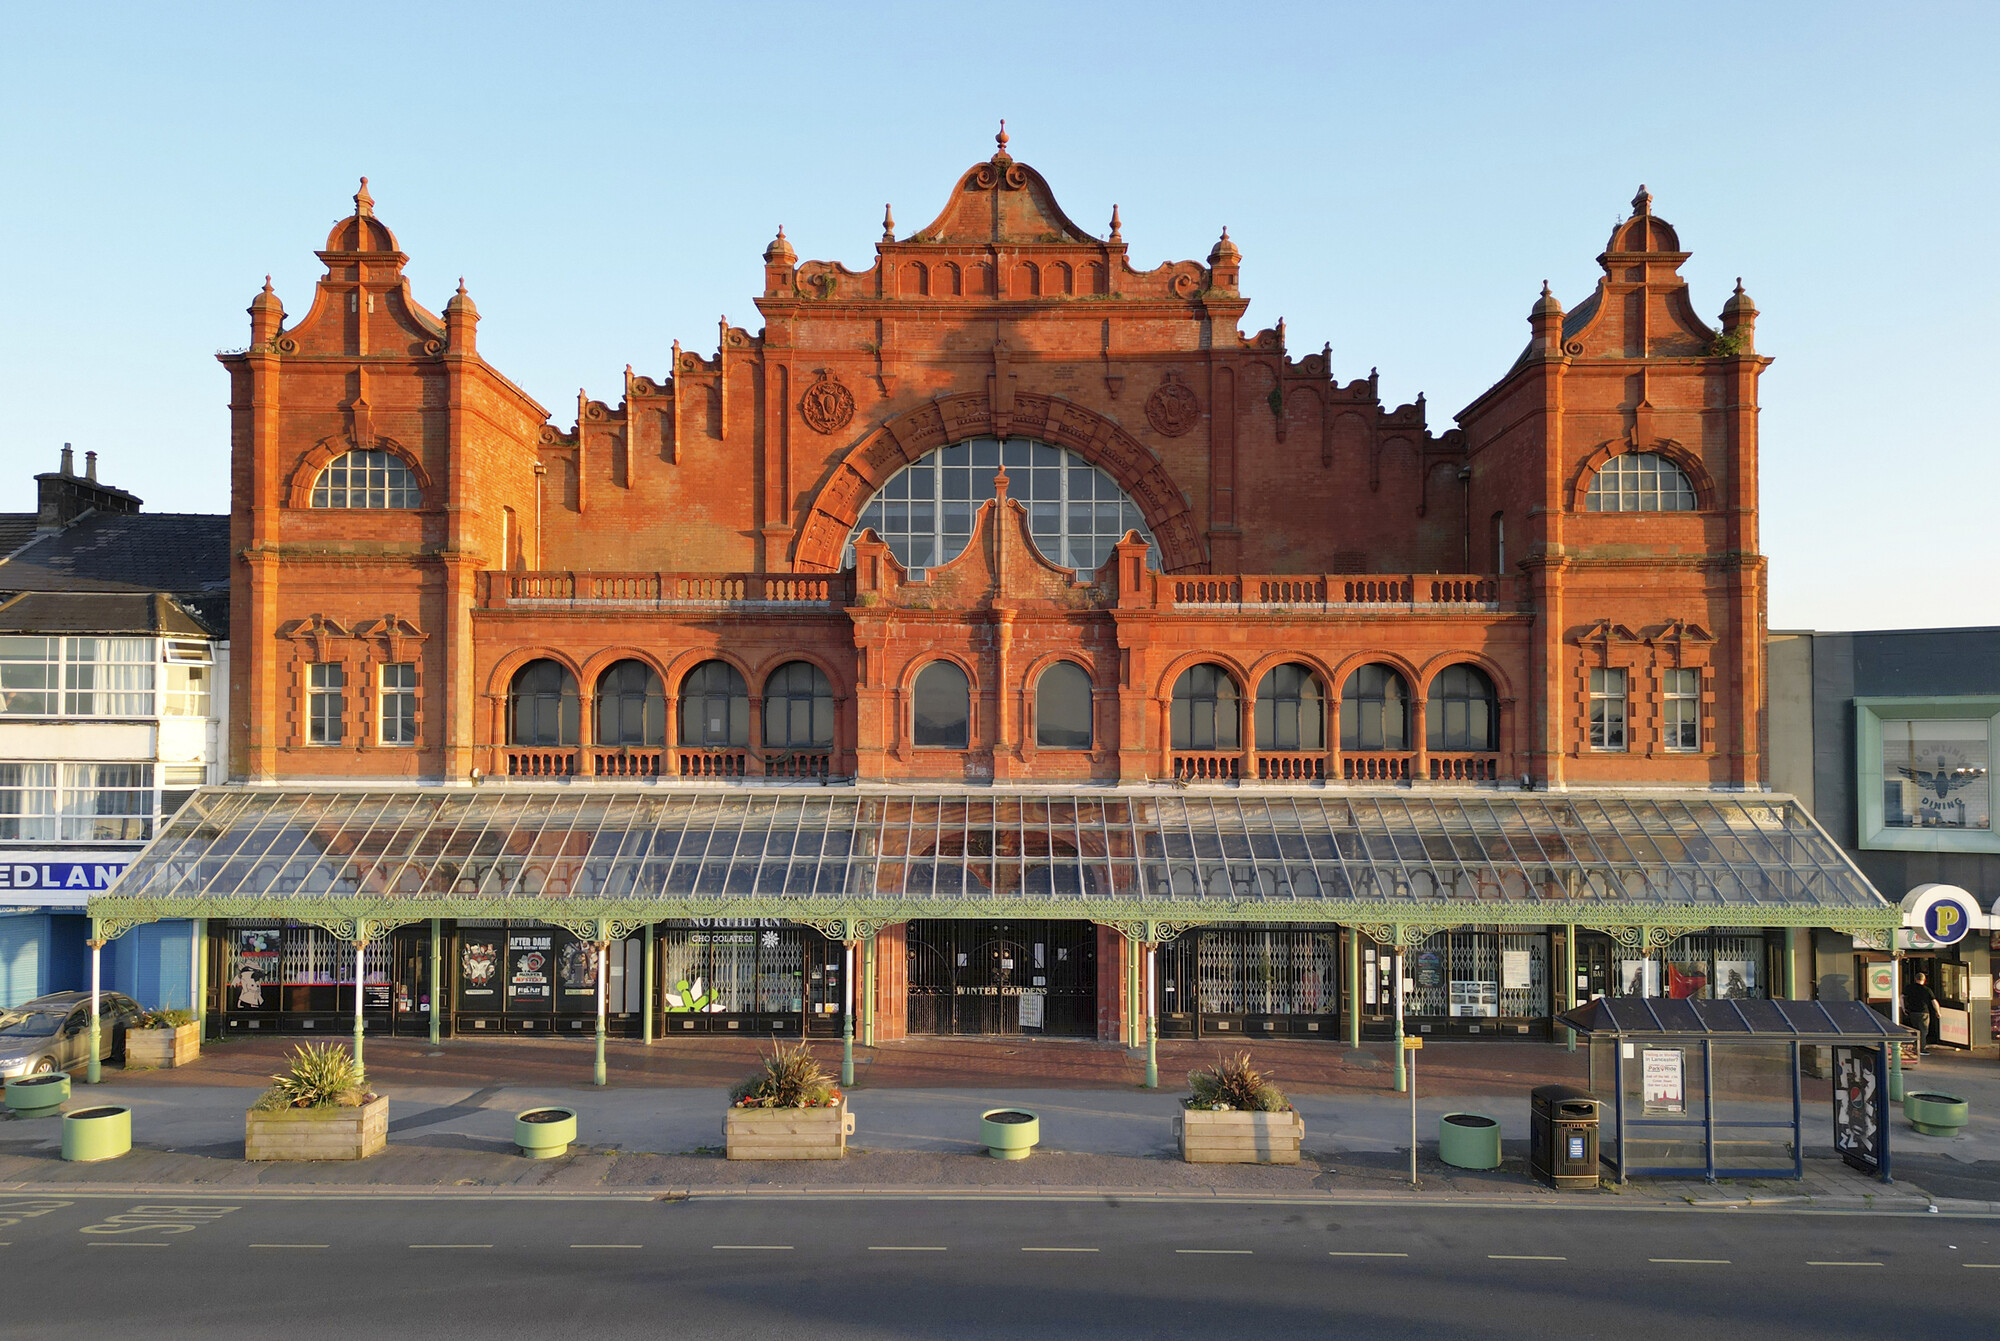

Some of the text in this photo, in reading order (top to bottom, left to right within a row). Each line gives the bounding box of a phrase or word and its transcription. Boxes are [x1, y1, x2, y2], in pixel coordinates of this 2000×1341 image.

[1921, 797, 1963, 810] DINING
[0, 865, 128, 888] EDLAN
[1935, 905, 1959, 937] P
[510, 937, 551, 946] AFTER DARK
[956, 987, 1048, 995] WINTER GARDENS
[79, 1205, 243, 1235] BUS
